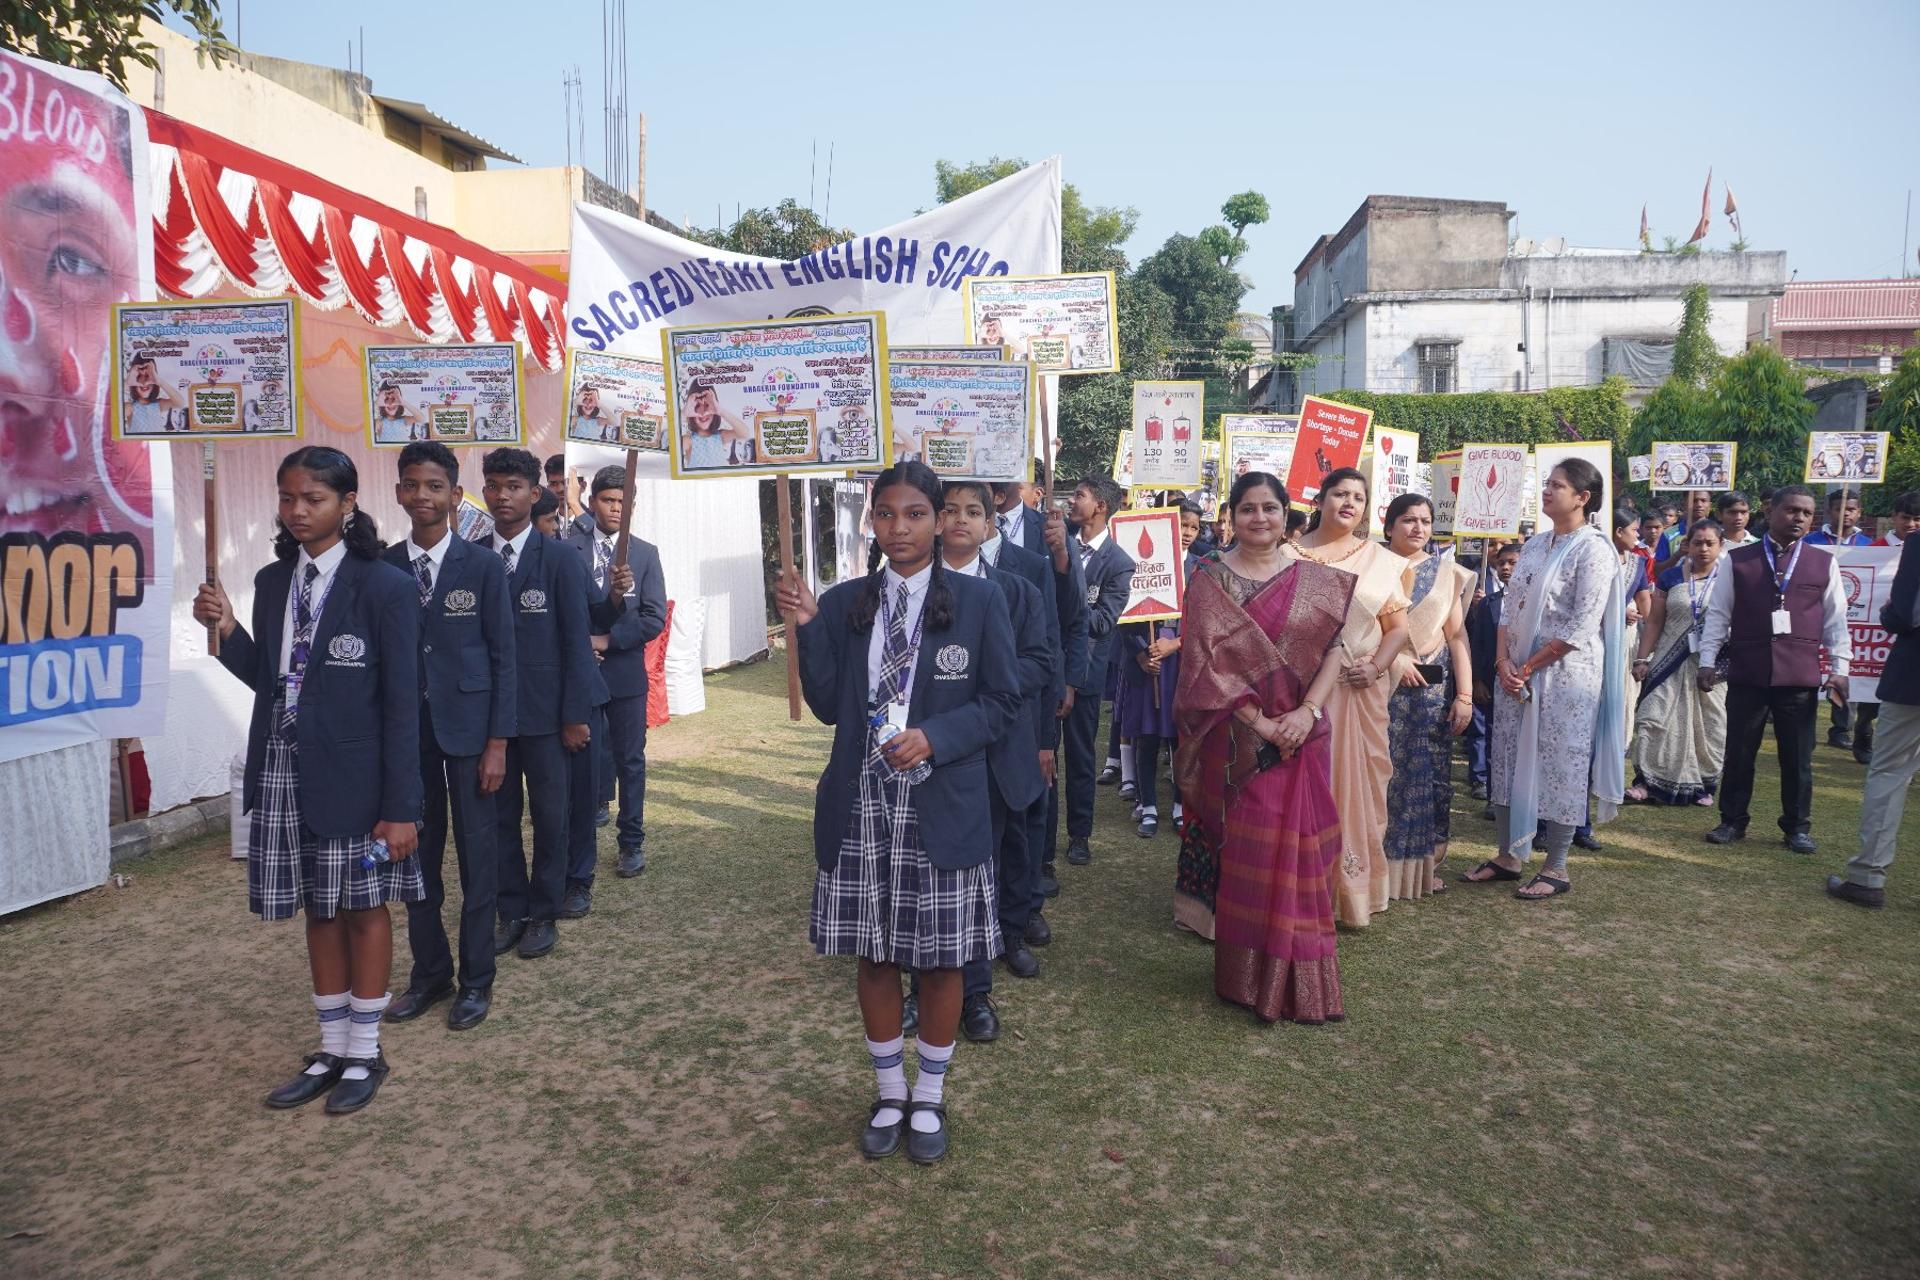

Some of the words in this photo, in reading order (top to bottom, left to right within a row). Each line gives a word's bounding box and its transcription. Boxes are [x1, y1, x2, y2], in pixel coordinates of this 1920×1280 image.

[0, 62, 106, 165] BLOOD
[571, 267, 695, 351] SACRED
[780, 236, 919, 287] ENGLISH
[778, 382, 820, 391] FOUNDATION
[1317, 409, 1338, 421] Severe
[1337, 413, 1357, 425] Blood
[1306, 418, 1333, 433] Shortage
[1337, 426, 1360, 439] Donate
[1321, 434, 1341, 448] Today
[1174, 448, 1187, 457] 90
[1468, 449, 1488, 461] GIVE
[1491, 449, 1521, 462] BLOOD
[1388, 467, 1394, 485] 3
[1438, 500, 1456, 509] रक्त
[1465, 517, 1486, 530] GIVE
[1487, 517, 1507, 529] LIFE
[1132, 573, 1173, 590] क्तदान
[0, 543, 138, 644] nor
[1854, 646, 1892, 662] HO
[0, 645, 125, 715] ION
